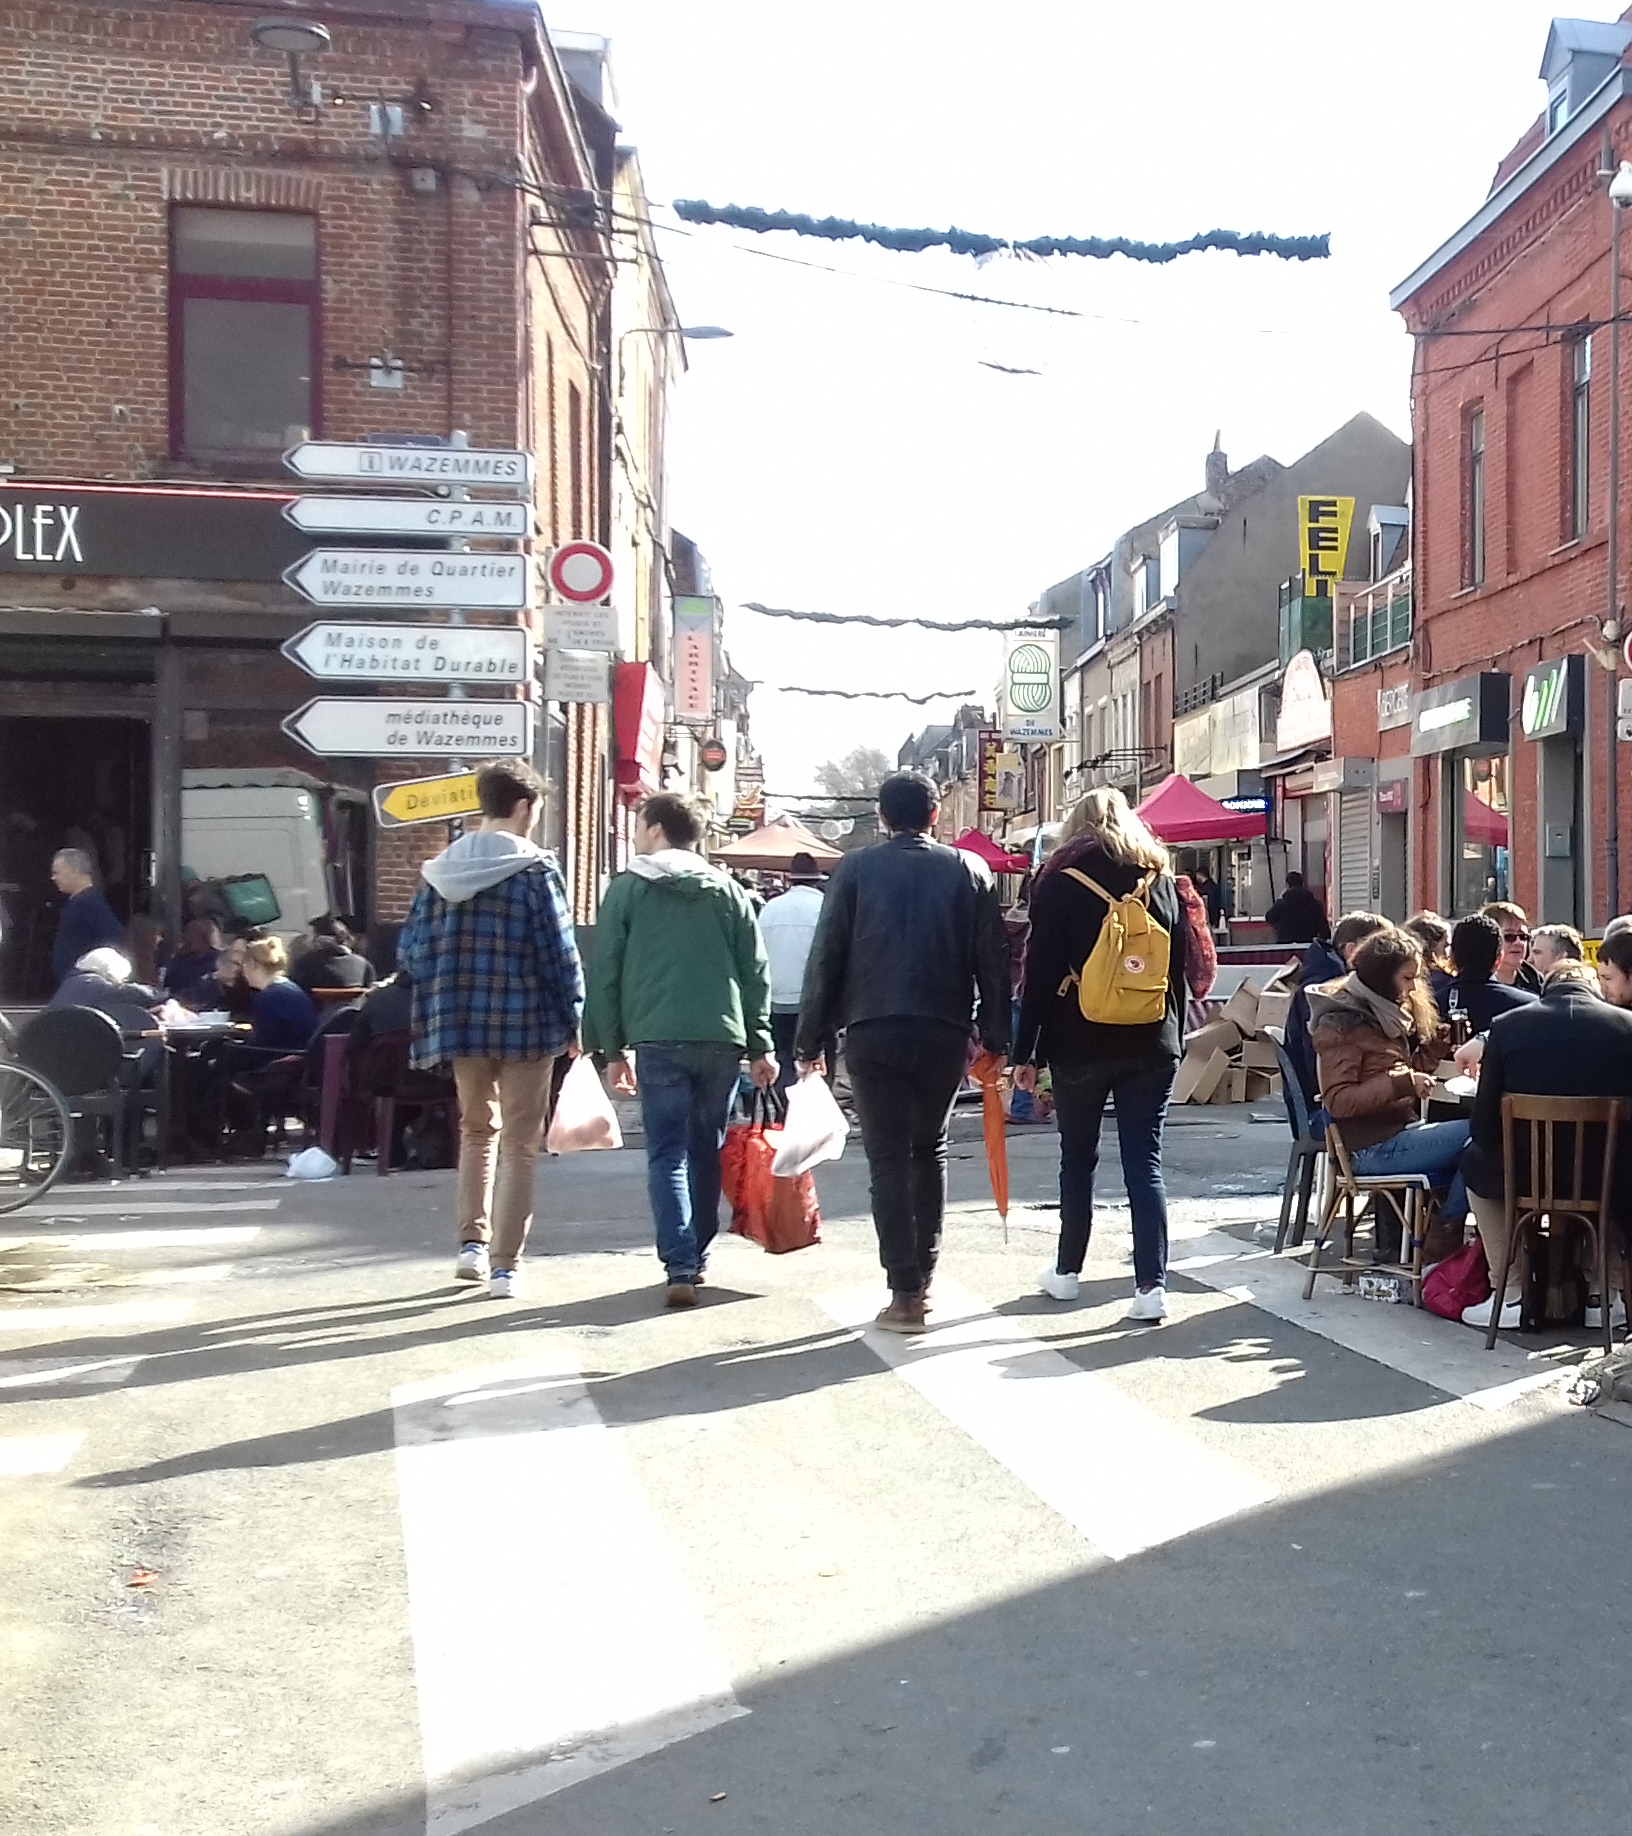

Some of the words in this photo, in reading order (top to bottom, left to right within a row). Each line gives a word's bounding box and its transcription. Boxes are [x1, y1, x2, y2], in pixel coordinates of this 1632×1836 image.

[388, 455, 518, 477] WAZEMMES
[426, 508, 518, 527] C.P.A.M.
[320, 558, 386, 576] Mairie
[397, 559, 420, 576] de
[431, 560, 516, 578] Quartier
[322, 580, 434, 598] Wazemmes
[324, 632, 403, 650] Maison
[414, 634, 440, 651] de
[323, 654, 421, 671] l'Habitat
[433, 656, 518, 674] Durable
[386, 709, 504, 728] médiathèque
[387, 730, 408, 746] de
[415, 730, 519, 747] Wazemmes
[1010, 728, 1054, 738] WAZEMMES
